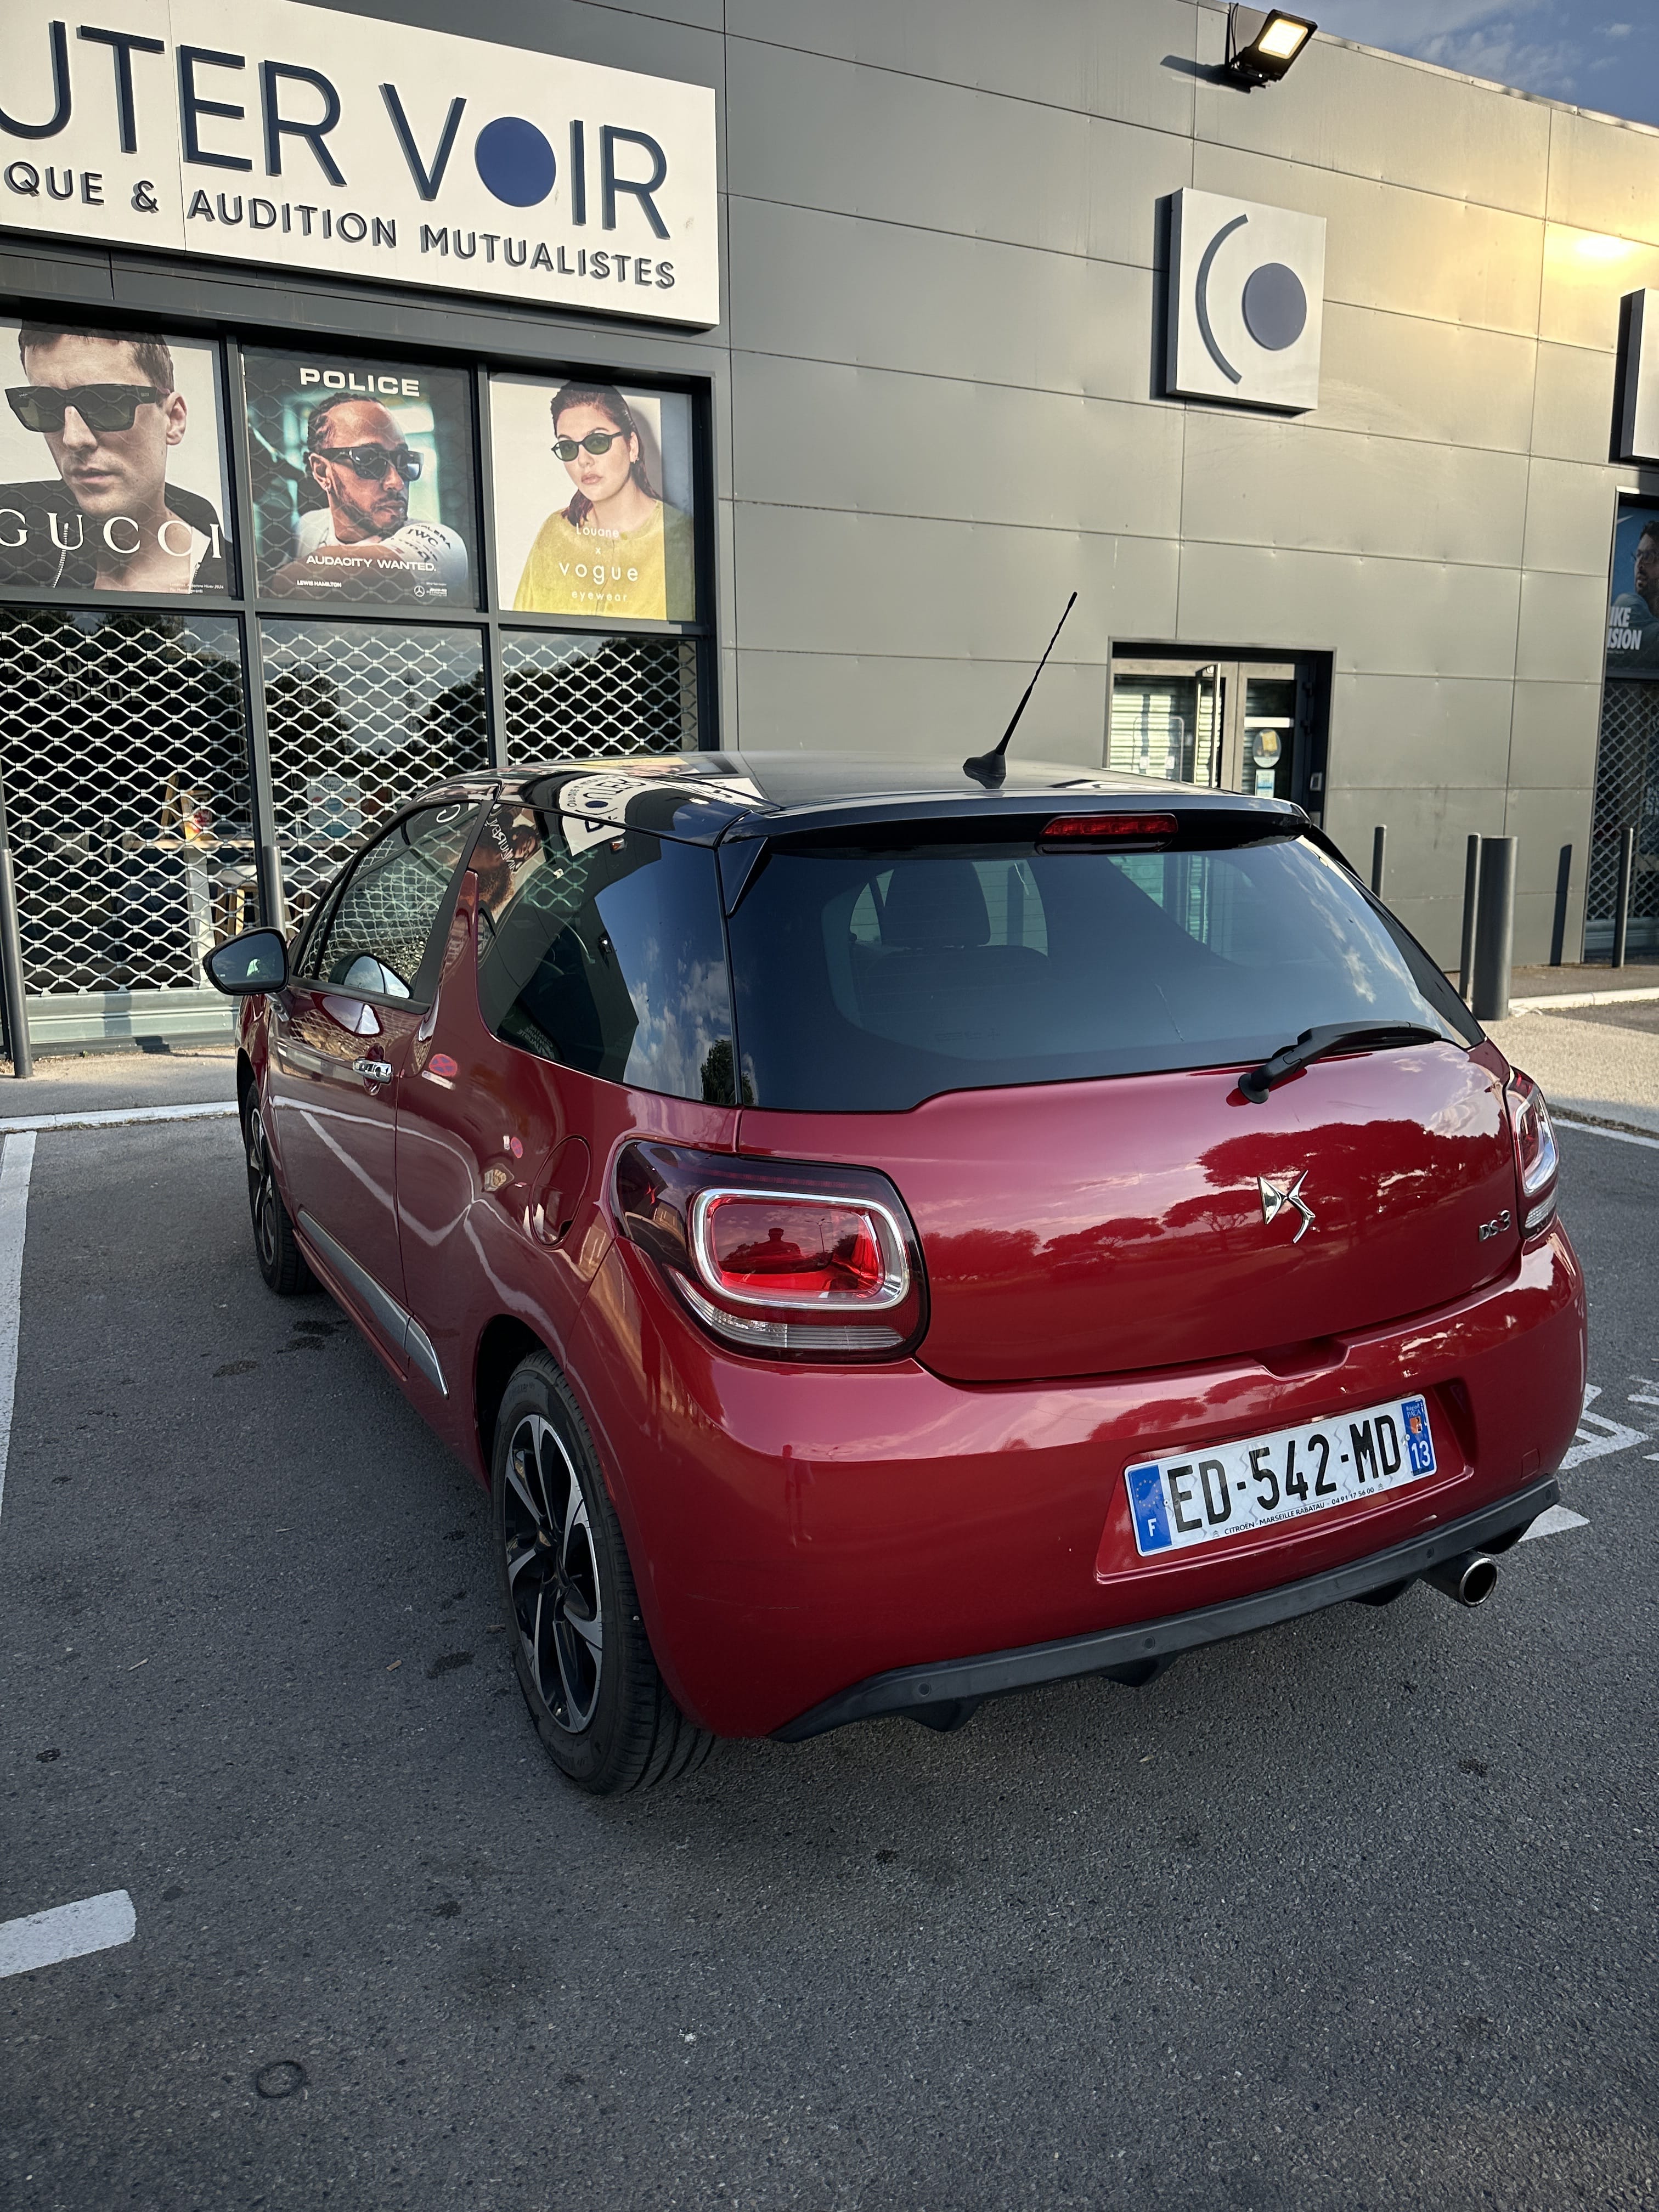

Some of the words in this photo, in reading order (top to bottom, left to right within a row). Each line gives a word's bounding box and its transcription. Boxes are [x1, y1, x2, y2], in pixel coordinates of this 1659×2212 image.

[379, 83, 670, 240] VOIR
[4, 161, 105, 205] QUE
[131, 180, 159, 213] &
[187, 189, 396, 249] AUDITION
[420, 224, 675, 289] MUTUALISTES
[300, 368, 420, 397] POLICE
[0, 509, 222, 558] GUCCI
[407, 529, 438, 547] IWC
[576, 523, 619, 538] Louane
[306, 555, 373, 568] AUDACITY
[377, 559, 437, 571] WANTED.
[559, 562, 638, 585] vogue
[572, 591, 627, 602] eyewear
[1407, 1409, 1421, 1418] PACA
[1411, 1440, 1431, 1469] 13
[1167, 1414, 1402, 1533] ED-542-MD
[1259, 1510, 1295, 1526] MARSEILLE
[1296, 1502, 1325, 1515] RABATAU
[1148, 1517, 1158, 1537] F
